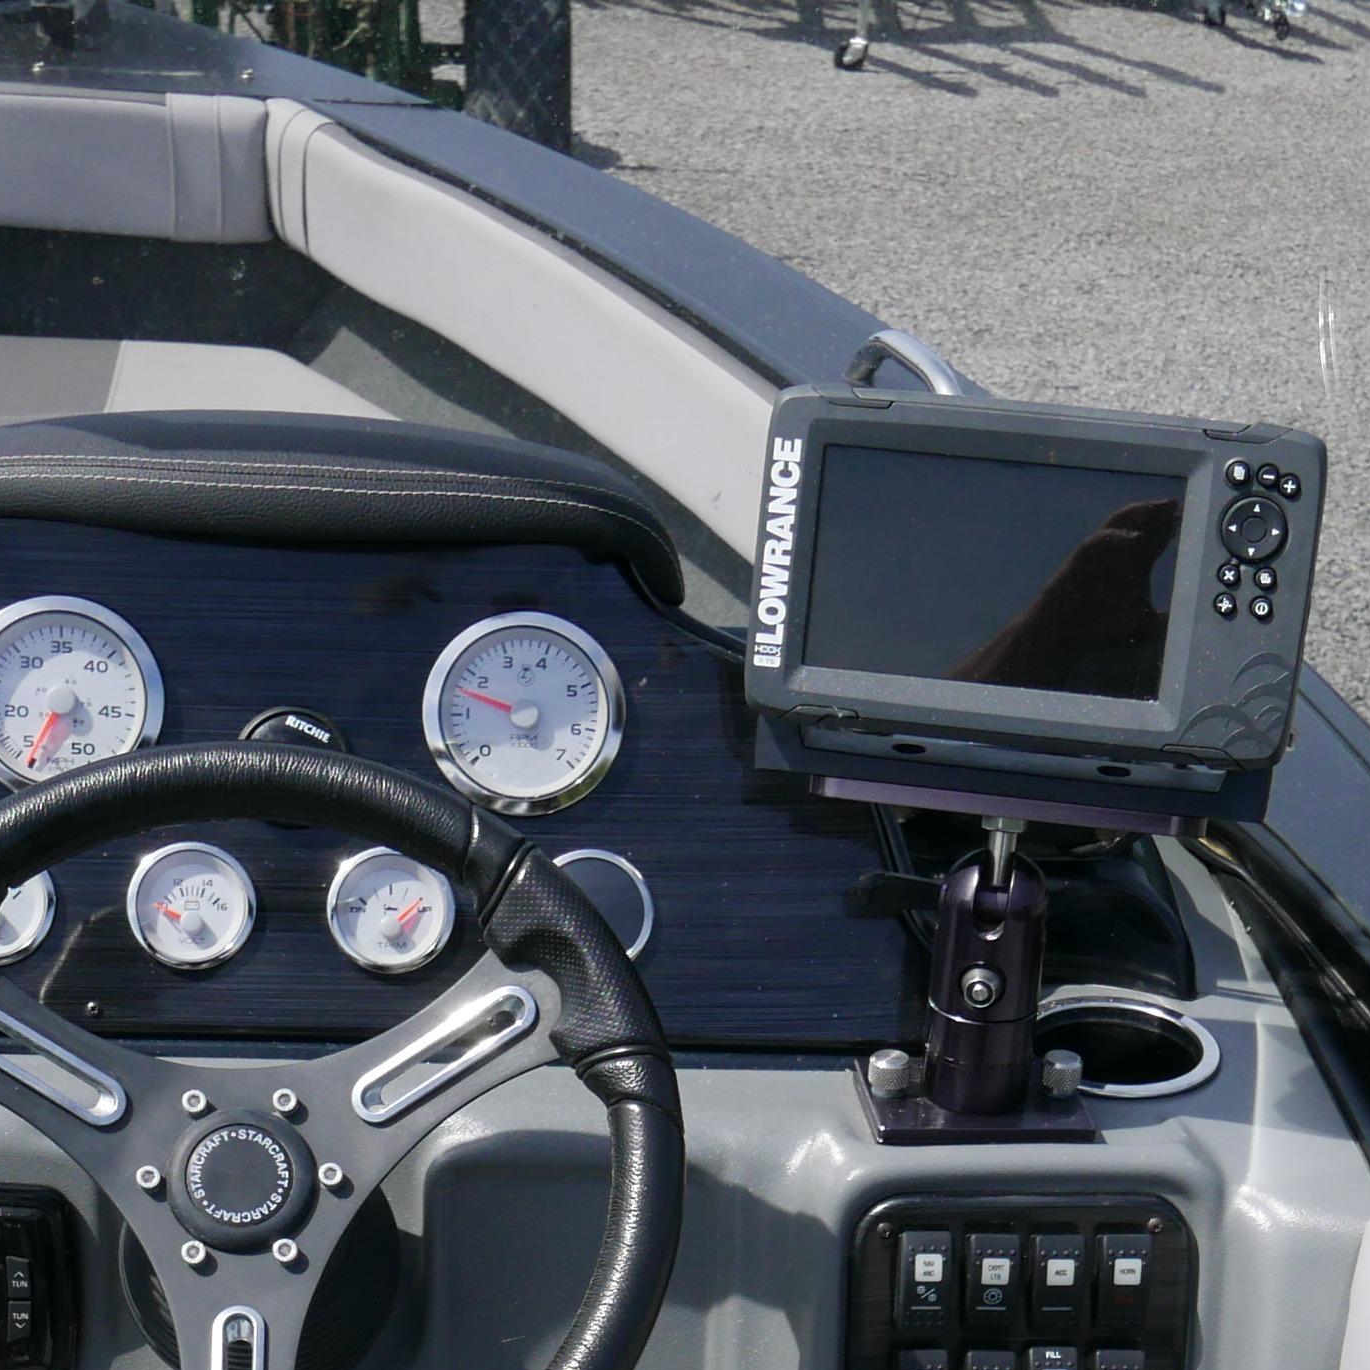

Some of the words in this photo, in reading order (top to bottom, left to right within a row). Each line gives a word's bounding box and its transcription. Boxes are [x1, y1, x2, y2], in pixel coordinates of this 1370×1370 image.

[755, 437, 803, 645] LOWRANCE
[50, 641, 73, 653] 35
[19, 656, 43, 669] 30
[83, 660, 108, 673] 40
[503, 657, 513, 668] 3
[535, 657, 547, 669] 4
[478, 677, 489, 688] 2
[567, 685, 577, 697] 5
[4, 705, 29, 718] 20
[98, 706, 122, 718] 45
[465, 707, 470, 720] 1
[285, 714, 331, 743] RITCHIE
[571, 724, 581, 735] 6
[71, 743, 95, 755] 50
[480, 744, 491, 756] 0
[556, 748, 566, 760] 7
[173, 878, 184, 886] 12
[217, 903, 228, 911] 16
[189, 1131, 229, 1199] STARCRAFT
[238, 1128, 290, 1190] STARCRAFT
[205, 1193, 282, 1223] STARCRAFT
